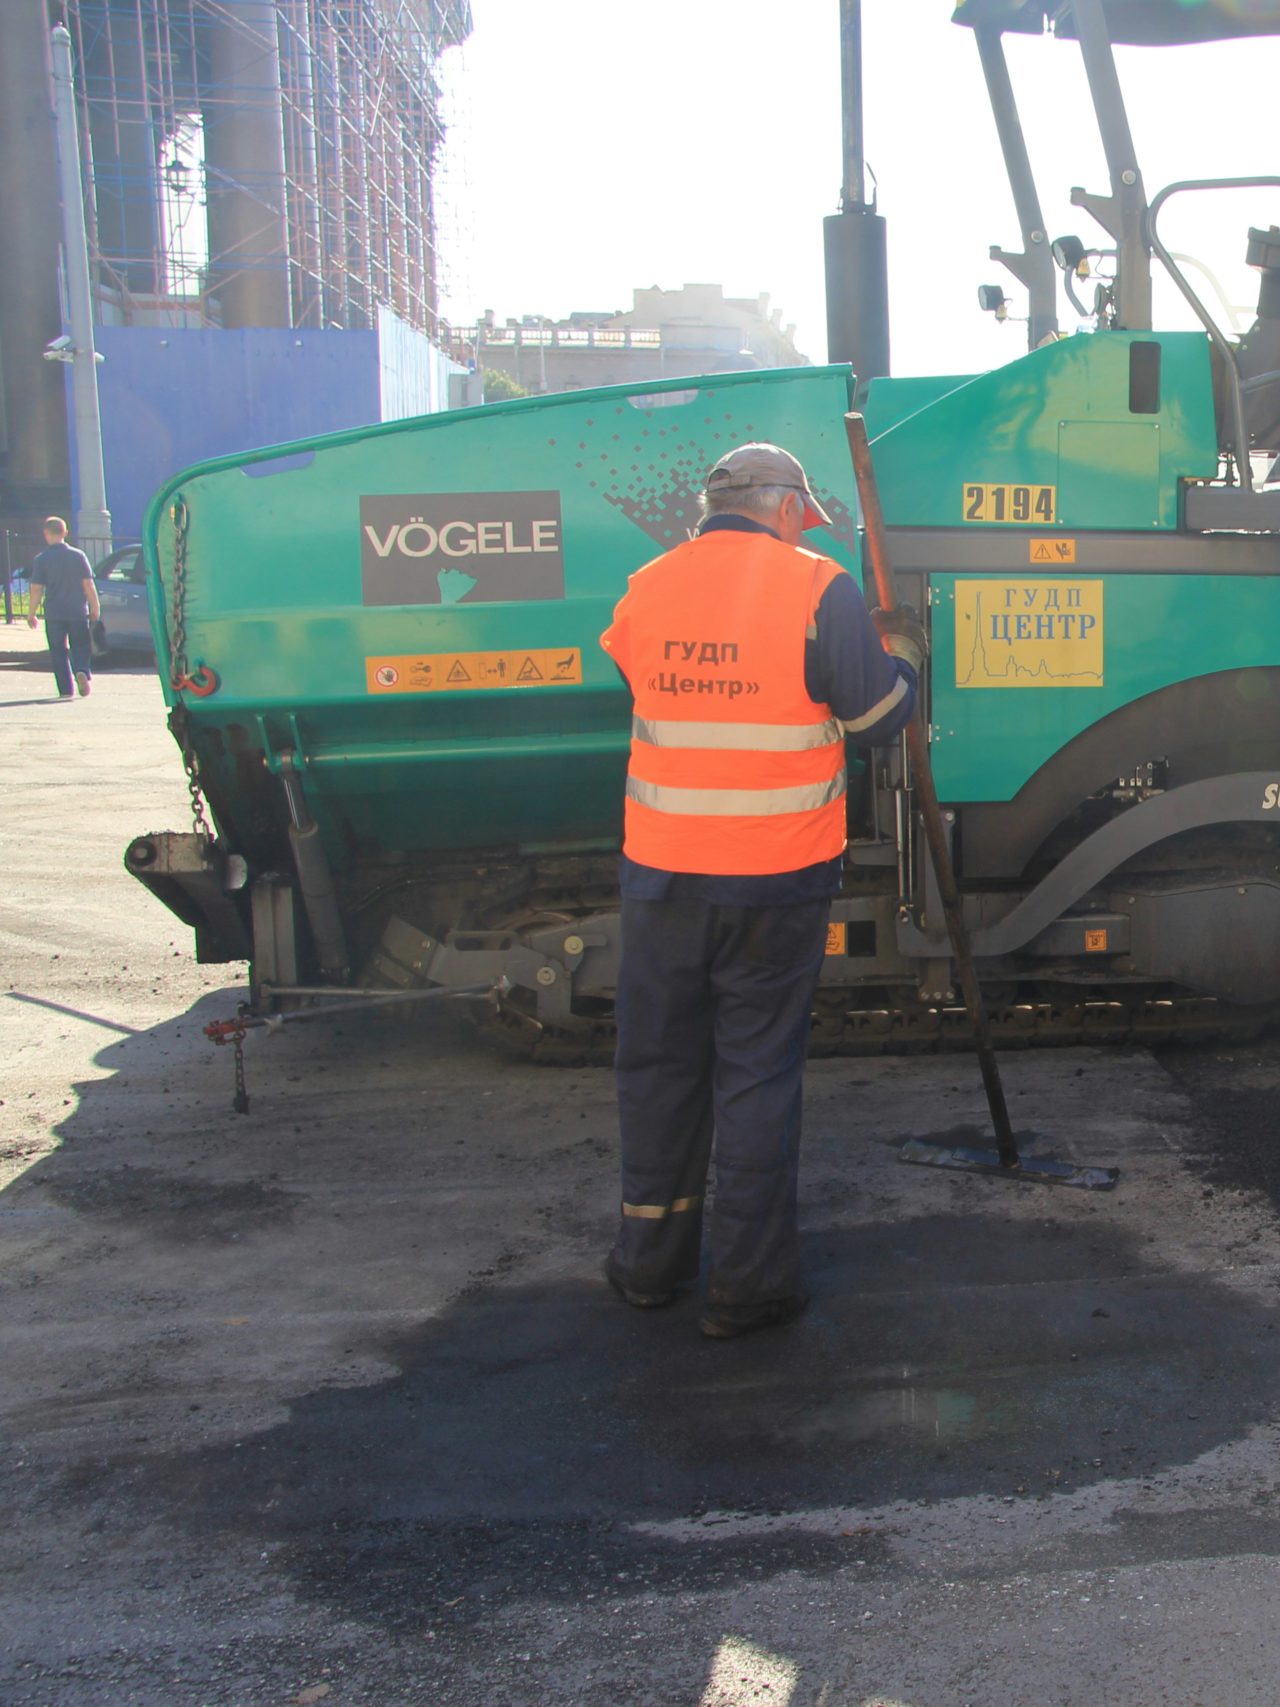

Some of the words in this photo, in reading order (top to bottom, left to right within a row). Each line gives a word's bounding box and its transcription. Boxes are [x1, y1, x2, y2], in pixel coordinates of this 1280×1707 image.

[966, 486, 1053, 521] 2194
[364, 516, 559, 557] VÖGELE
[1004, 588, 1082, 611] ГУДП
[990, 614, 1096, 646] ЦЕНТР
[664, 640, 738, 666] ГУДП
[648, 672, 760, 700] «Центр»
